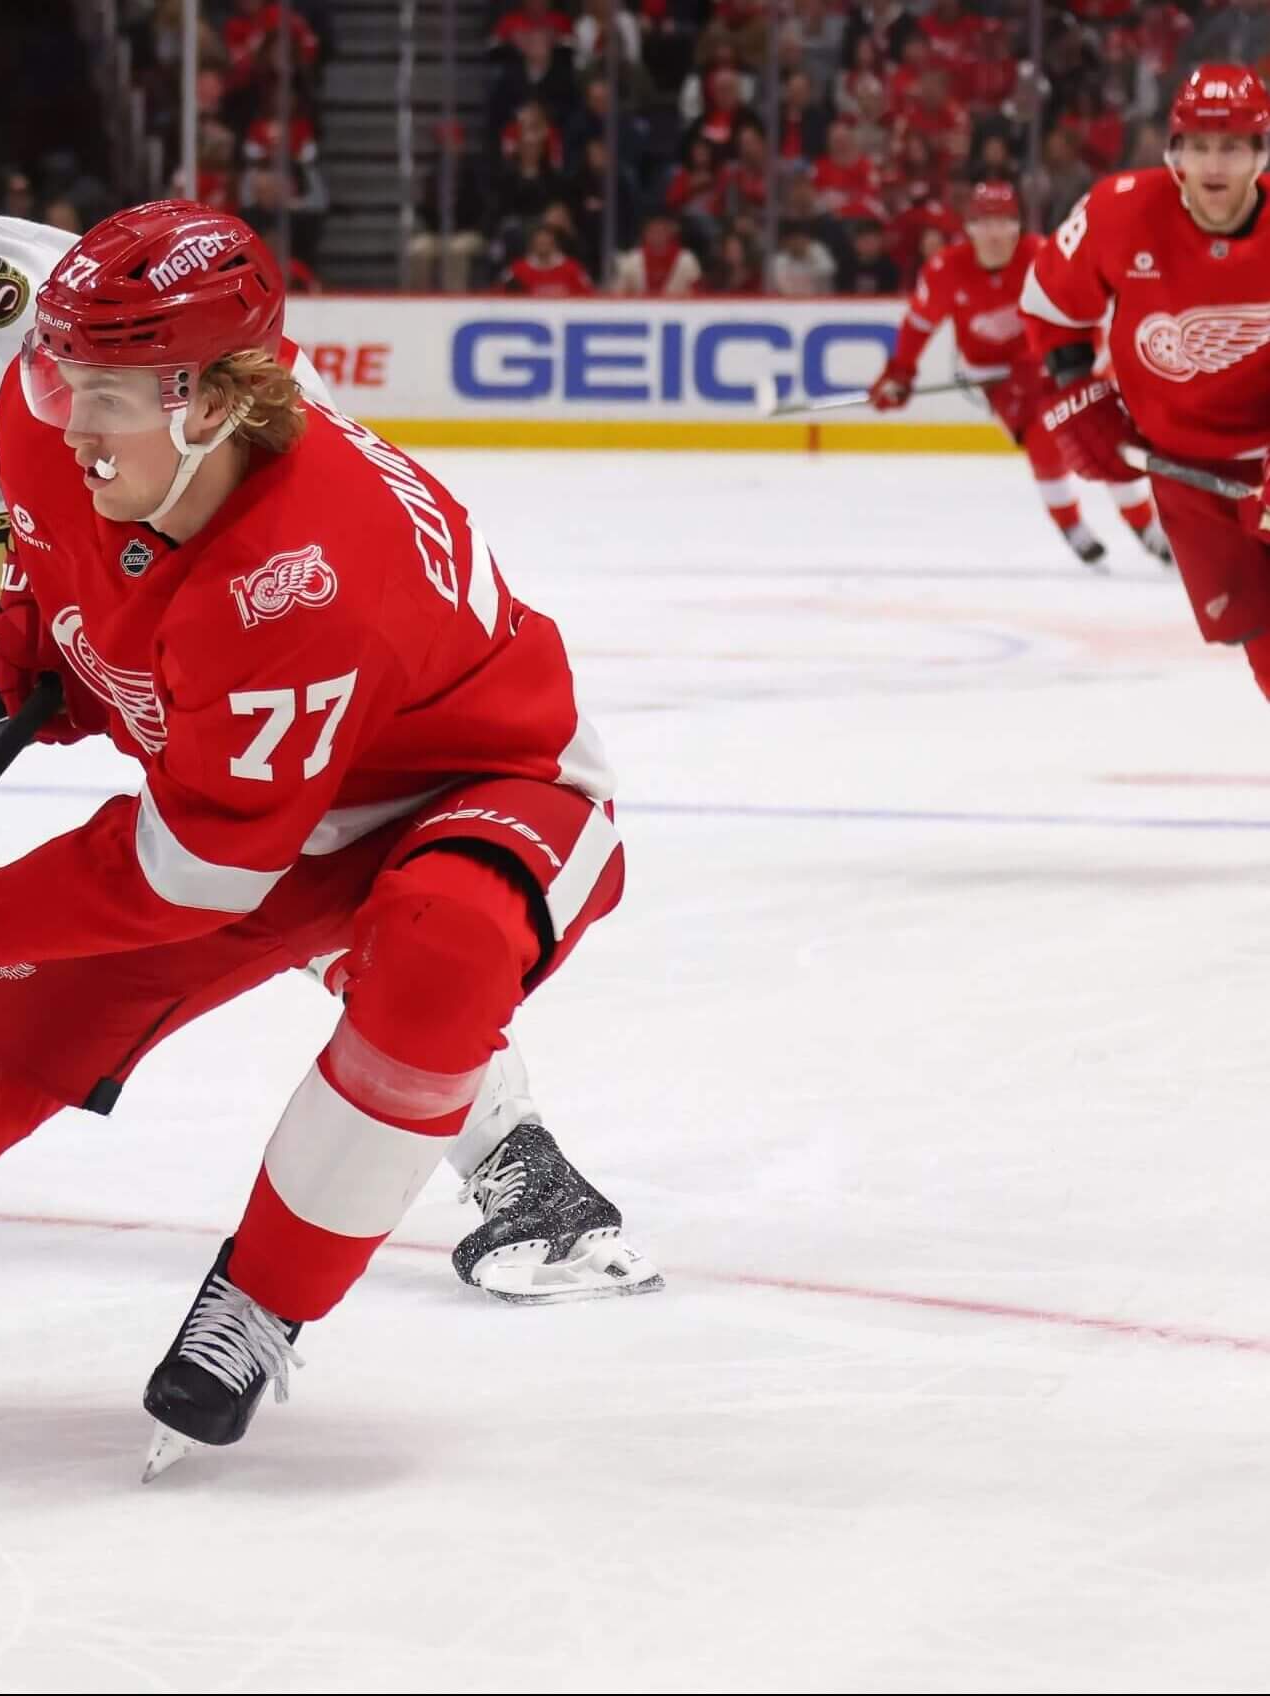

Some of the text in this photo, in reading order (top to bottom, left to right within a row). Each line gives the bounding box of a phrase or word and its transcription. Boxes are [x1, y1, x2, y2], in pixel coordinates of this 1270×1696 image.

[58, 253, 101, 293] 77
[147, 231, 226, 292] meijer
[38, 311, 73, 333] BAUER
[312, 343, 392, 387] RE
[452, 320, 897, 403] GEICO
[1042, 379, 1112, 432] BAUE
[11, 519, 51, 552] ORITY
[228, 668, 358, 782] 77
[415, 807, 563, 868] BAUER
